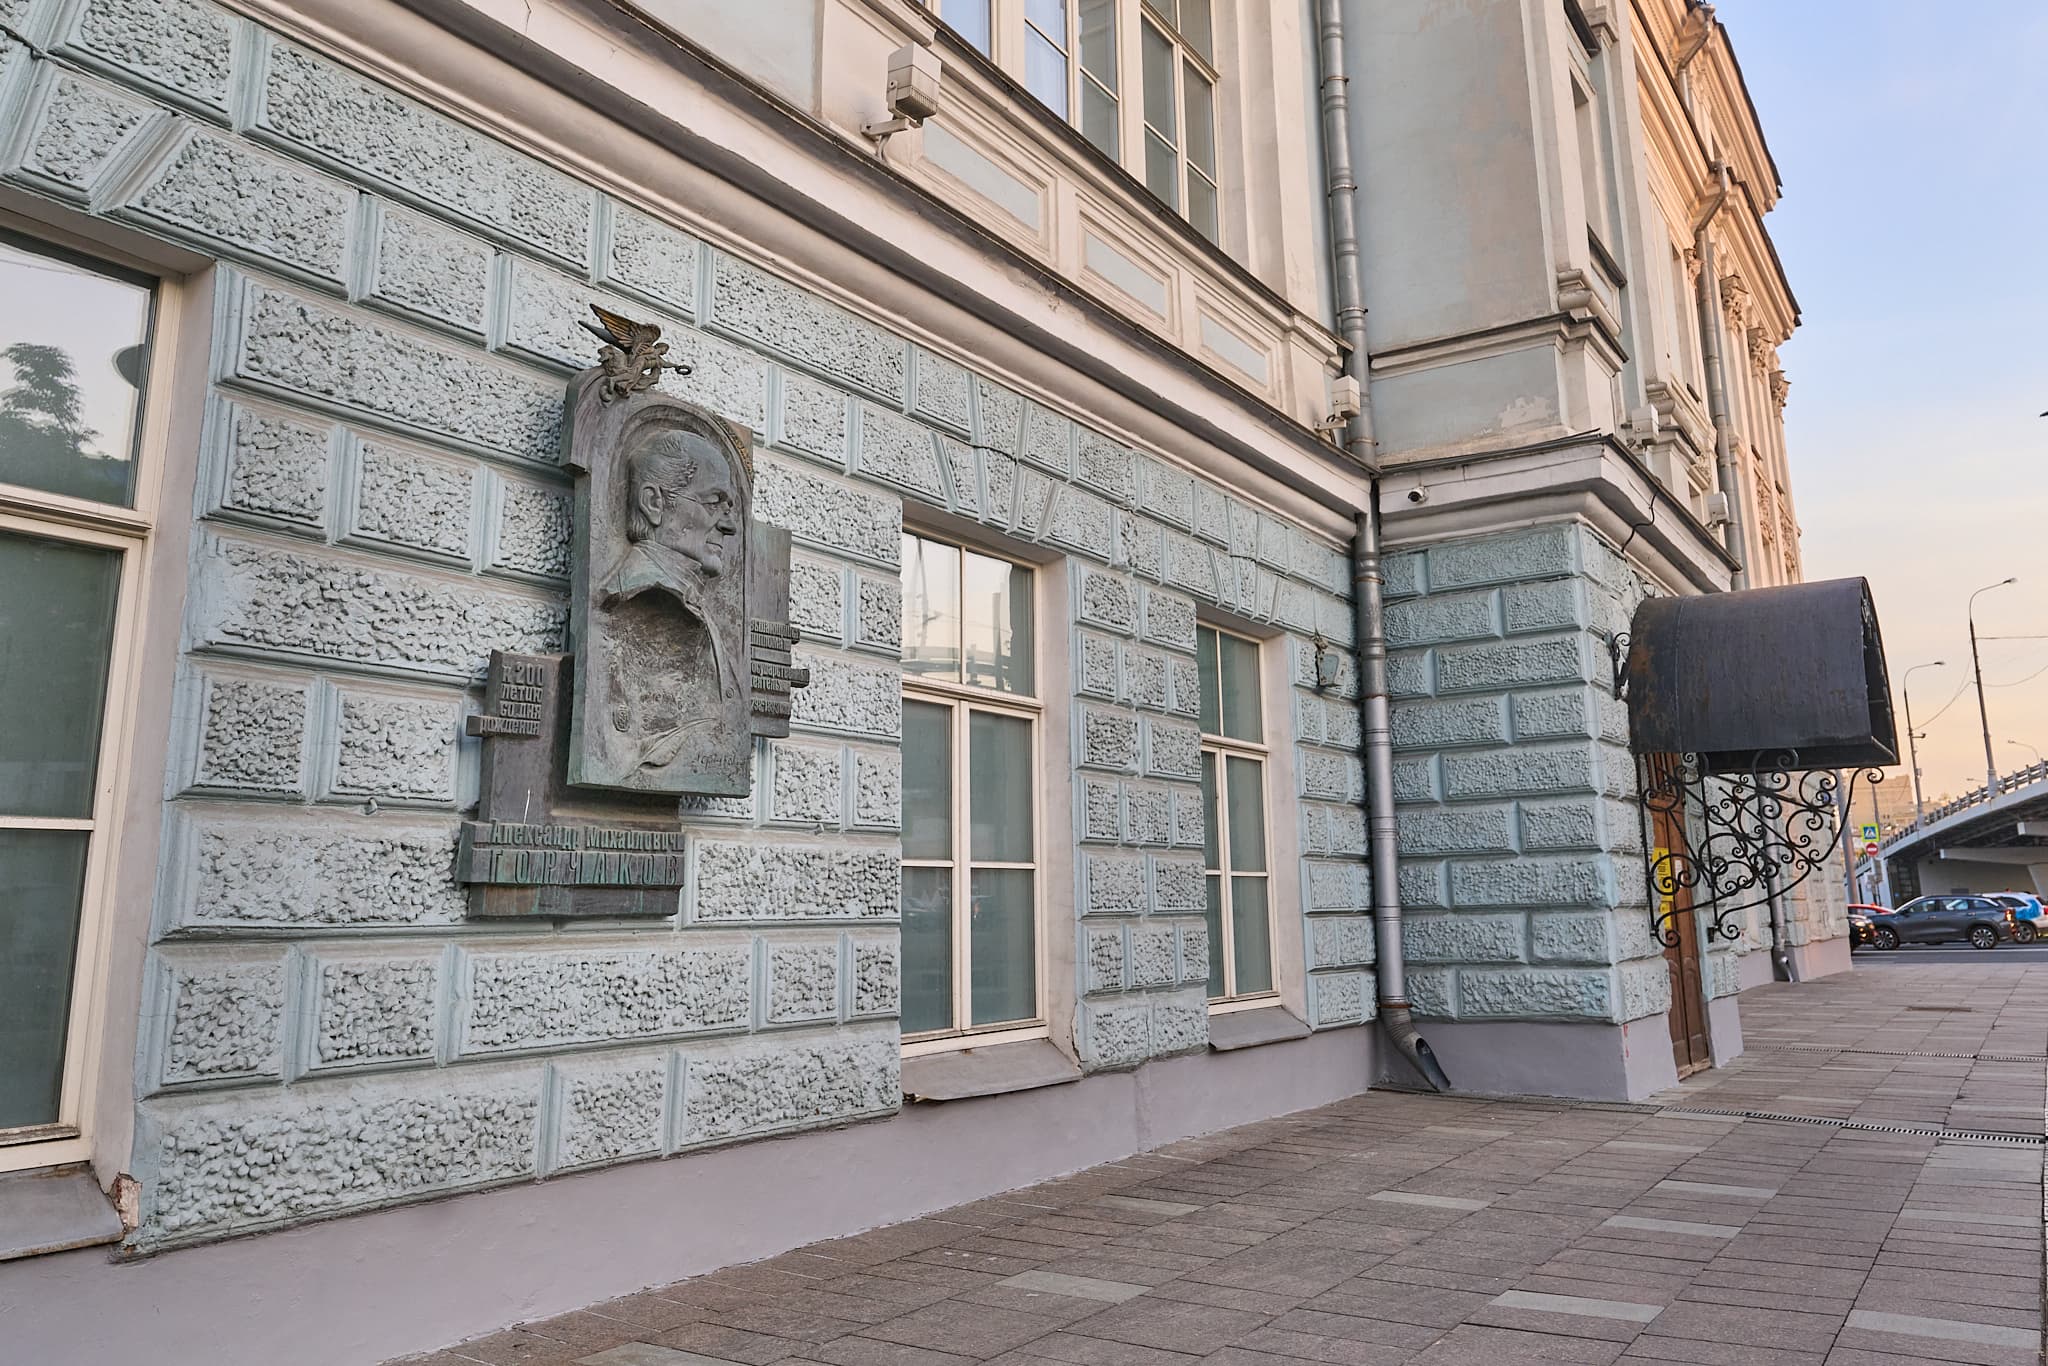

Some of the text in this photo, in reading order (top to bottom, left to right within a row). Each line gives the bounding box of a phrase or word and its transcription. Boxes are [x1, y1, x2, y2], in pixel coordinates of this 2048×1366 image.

[515, 661, 544, 686] 200
[752, 675, 780, 691] еятель
[502, 683, 543, 703] летию
[515, 703, 541, 720] дня
[480, 717, 540, 736] рождения
[491, 820, 580, 850] Александр
[490, 849, 677, 886] ГОРЧАКОВ
